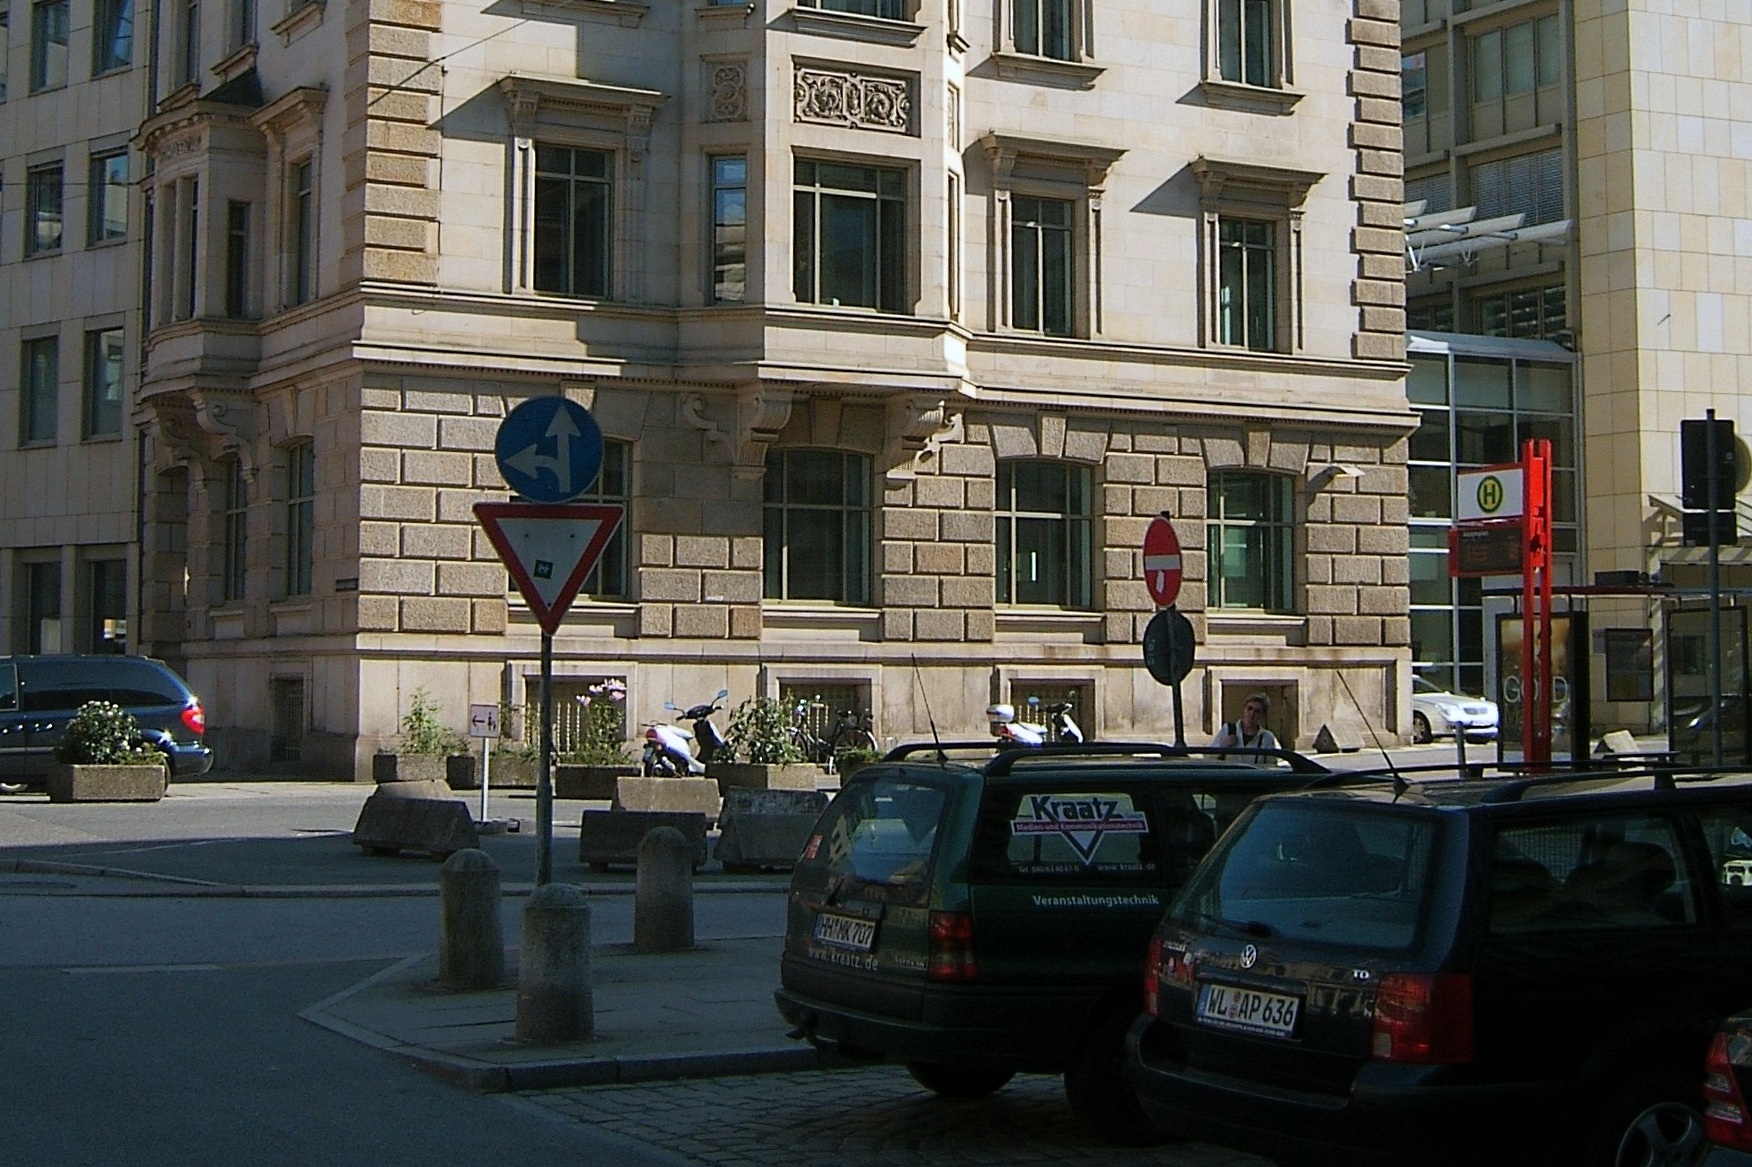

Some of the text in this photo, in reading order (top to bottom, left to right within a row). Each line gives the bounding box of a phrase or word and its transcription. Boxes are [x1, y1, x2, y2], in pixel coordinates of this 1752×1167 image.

[1483, 484, 1496, 504] H
[1503, 675, 1568, 703] GOD
[1031, 796, 1123, 821] Kraatz
[1033, 894, 1159, 907] Veranstaltungstechnik
[1238, 993, 1261, 1020] AP
[1262, 997, 1295, 1026] 636
